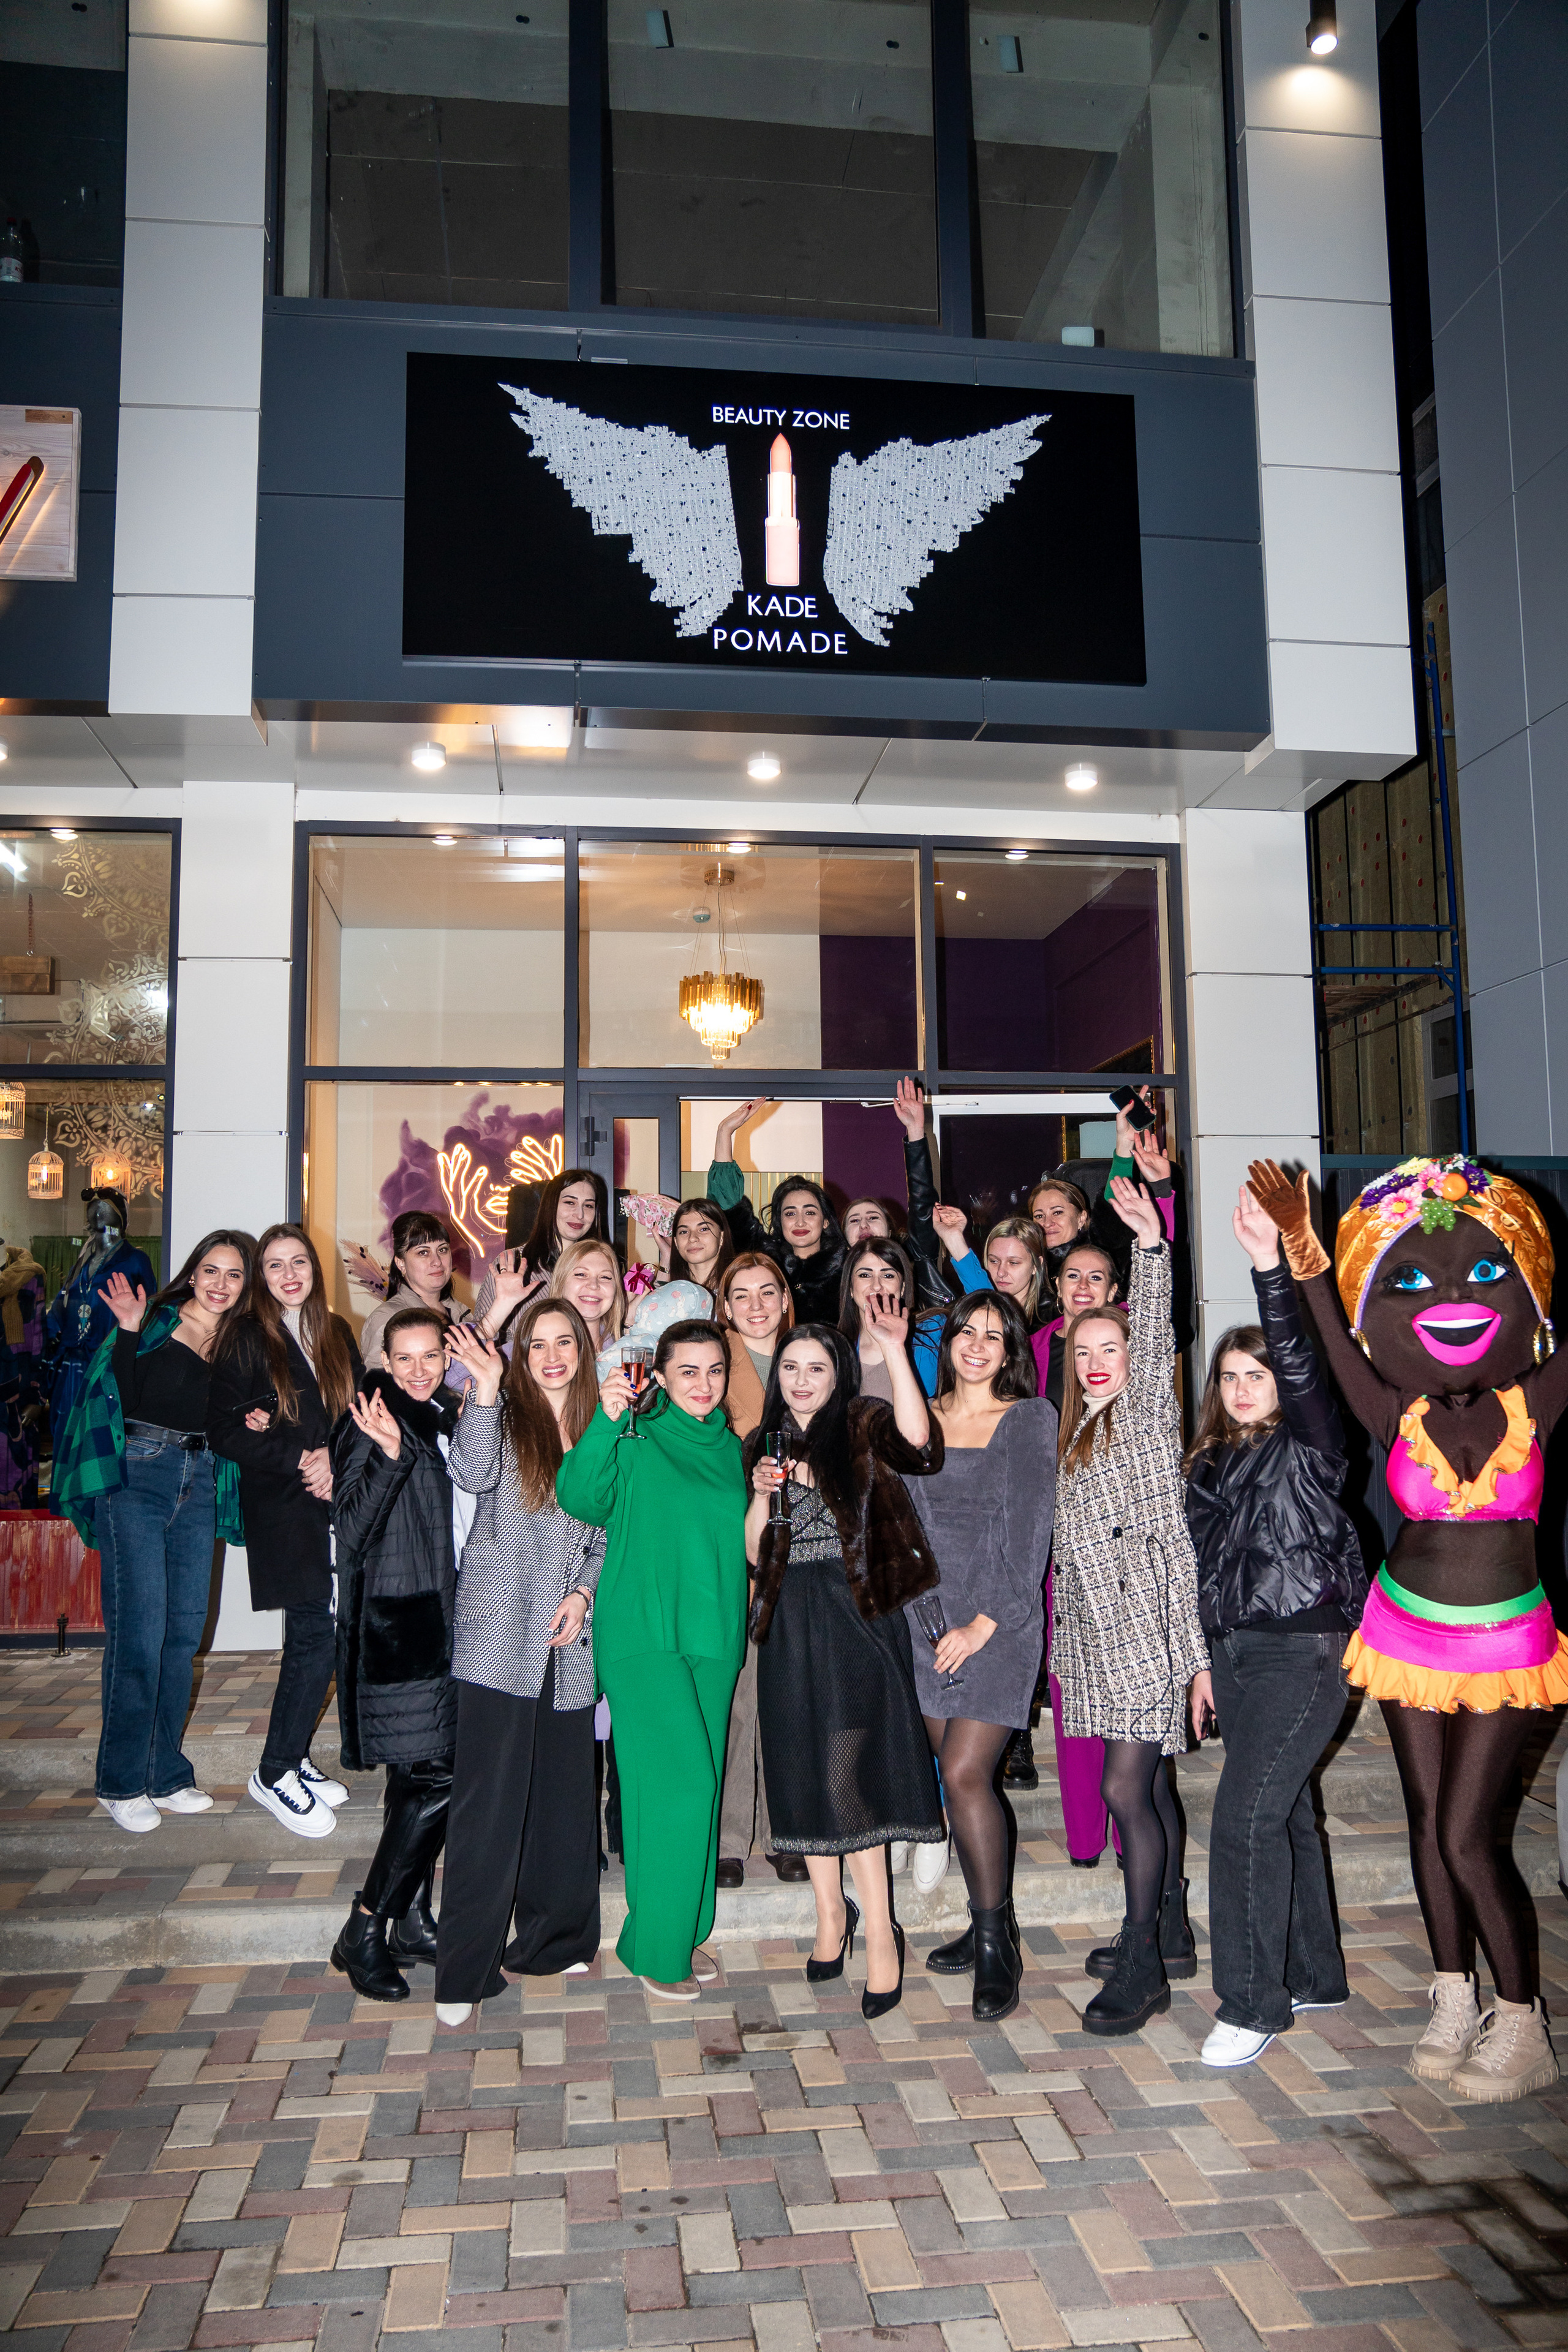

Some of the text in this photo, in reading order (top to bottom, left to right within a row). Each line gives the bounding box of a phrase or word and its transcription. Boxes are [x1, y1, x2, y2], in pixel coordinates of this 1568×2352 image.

[712, 406, 850, 430] BEAUTY ZONE
[747, 595, 818, 618] KADE
[714, 628, 848, 655] POMADE
